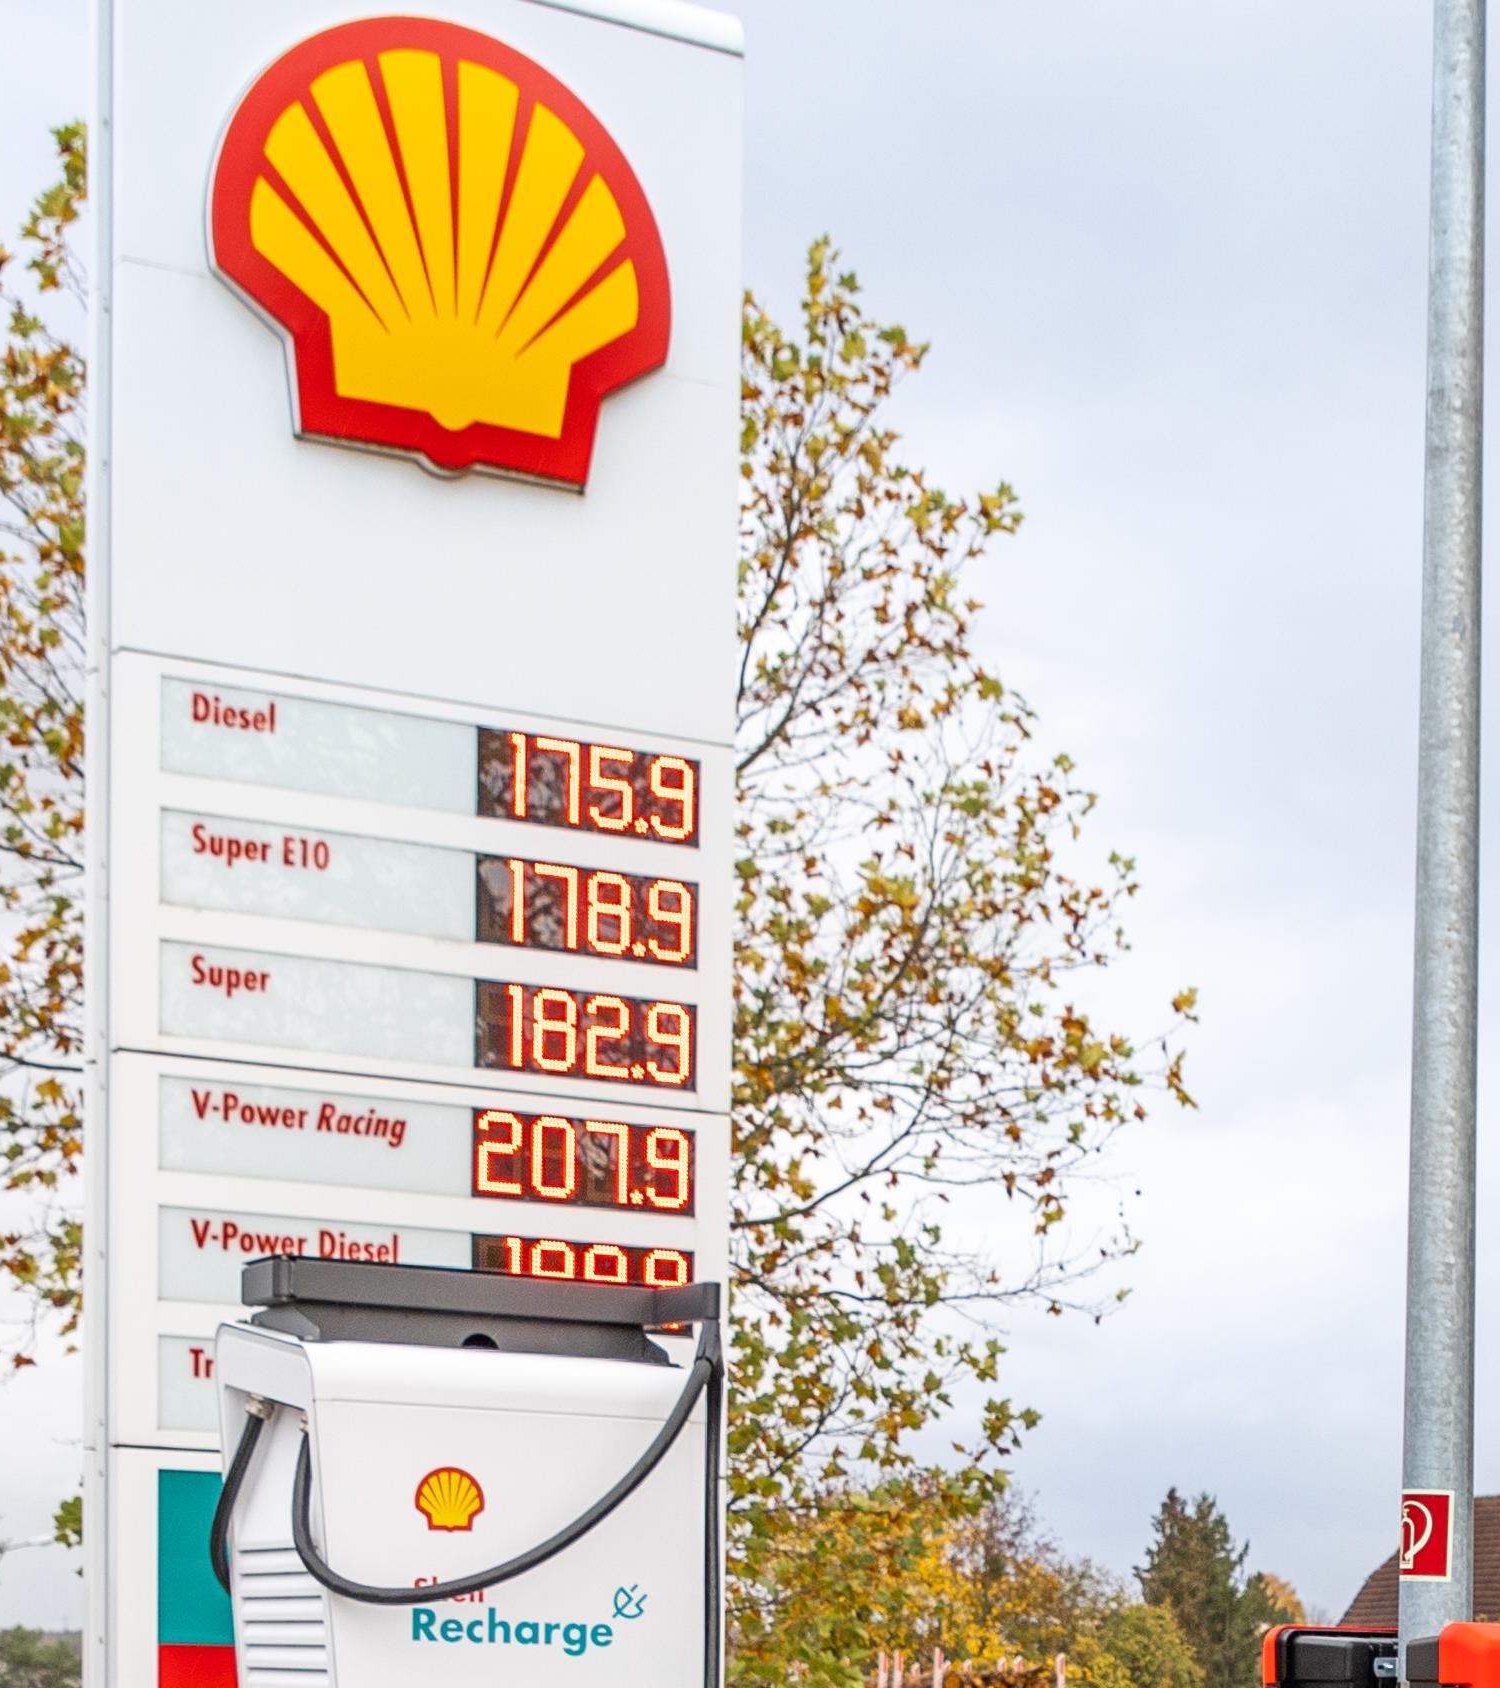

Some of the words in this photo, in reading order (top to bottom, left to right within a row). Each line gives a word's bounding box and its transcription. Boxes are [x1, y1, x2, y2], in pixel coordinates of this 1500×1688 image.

[191, 693, 277, 732] Diesel
[508, 733, 695, 841] 175.9
[192, 825, 271, 869] Super
[283, 838, 330, 870] E10
[508, 860, 694, 964] 178.9
[192, 956, 270, 998] Super
[506, 984, 693, 1086] 182.9
[191, 1090, 308, 1129] V-Power
[317, 1104, 407, 1149] Racing
[477, 1111, 691, 1211] 207.9
[190, 1218, 307, 1256] V-Power
[318, 1230, 400, 1264] Diesel
[411, 1607, 614, 1657] Recharge
